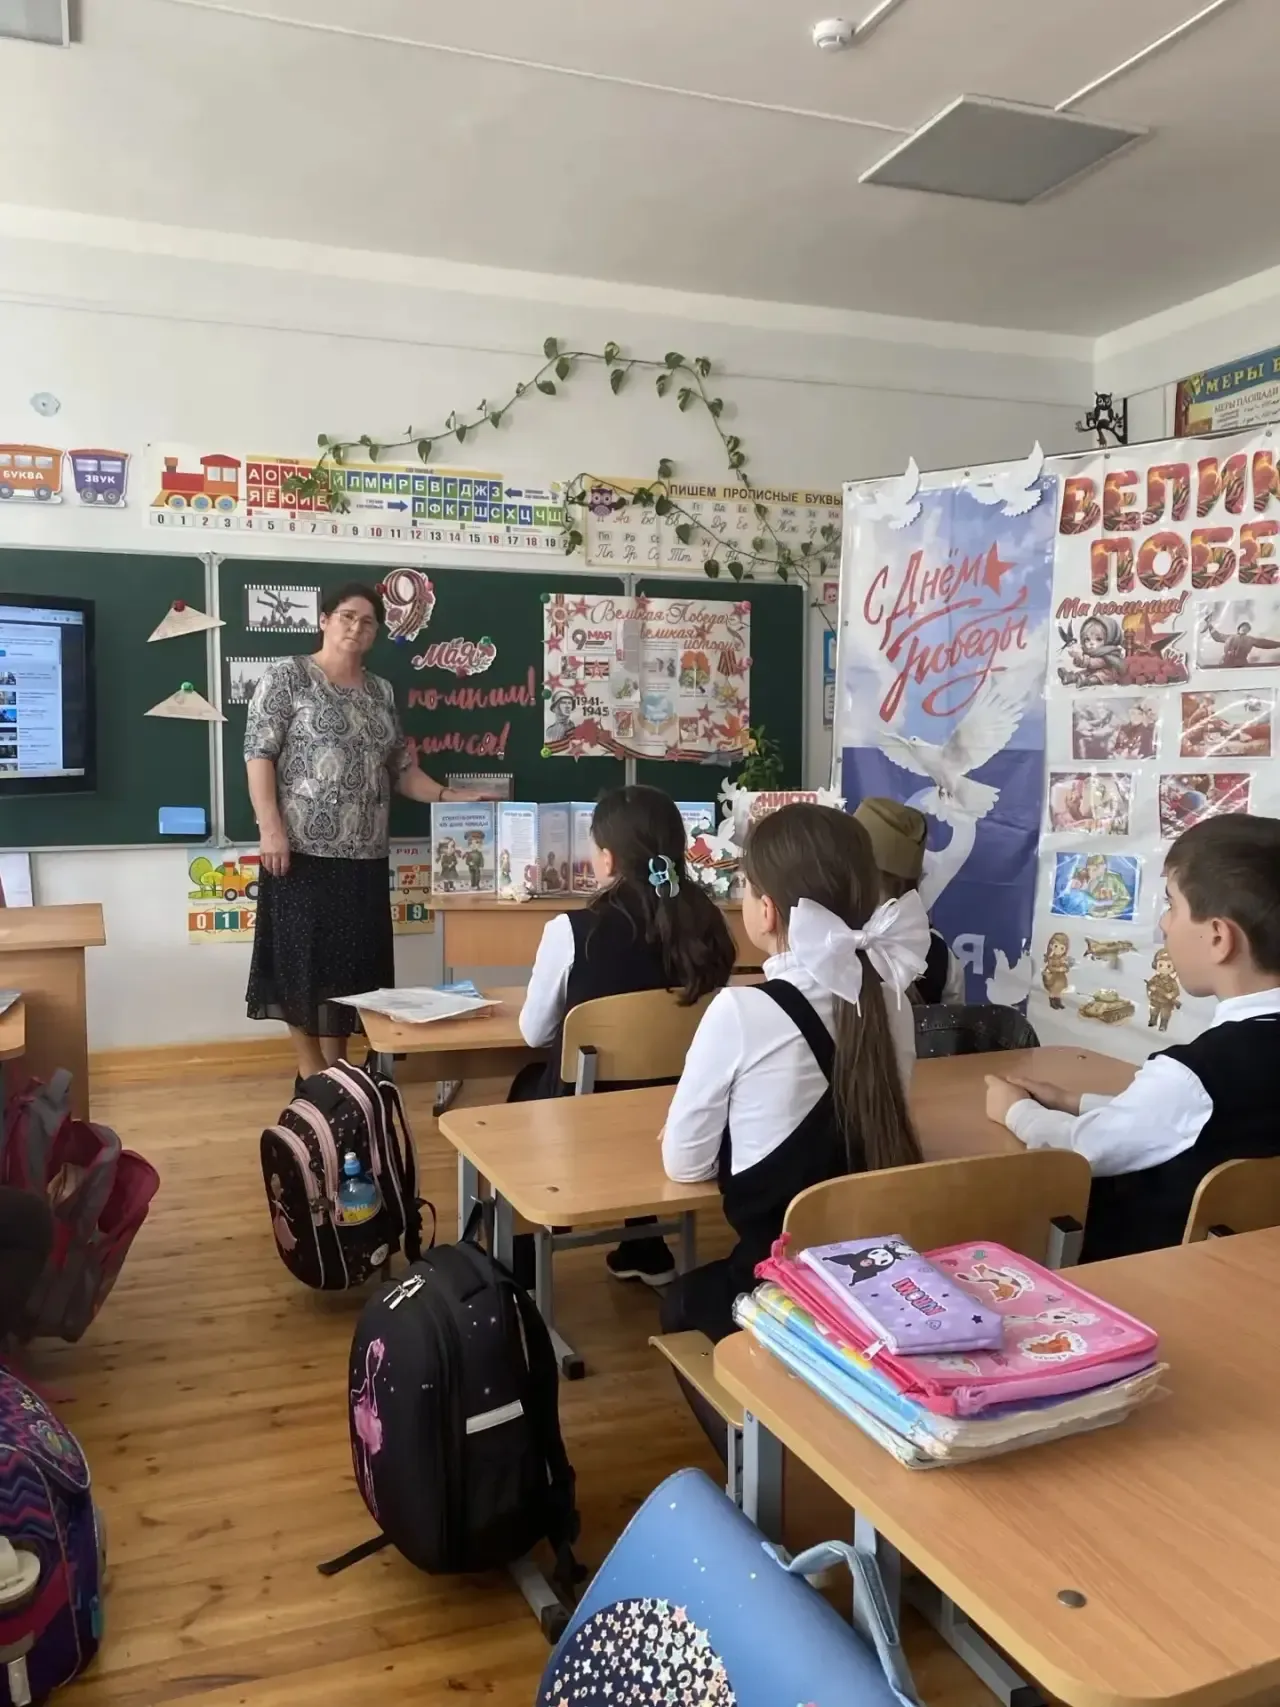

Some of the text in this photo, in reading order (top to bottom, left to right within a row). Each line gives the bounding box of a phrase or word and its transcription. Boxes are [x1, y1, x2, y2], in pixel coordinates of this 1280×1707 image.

[1206, 362, 1264, 395] МЕРЫ
[3, 470, 44, 480] БУКВА
[84, 474, 116, 484] ЗВУК
[249, 468, 260, 480] А
[265, 470, 278, 481] О
[349, 475, 360, 486] Л
[365, 476, 377, 488] М
[382, 478, 393, 489] Н
[399, 479, 409, 490] Р
[415, 480, 425, 491] Б
[430, 481, 441, 492] В
[447, 483, 455, 493] Г
[461, 484, 472, 496] Д
[474, 485, 488, 496] Ж
[491, 487, 500, 497] З
[249, 490, 260, 502] Я
[267, 488, 277, 503] Ё
[281, 492, 296, 504] Ю
[415, 502, 424, 513] П
[429, 503, 441, 514] Ф
[446, 504, 455, 515] К
[461, 506, 472, 516] Т
[491, 508, 501, 518] С
[505, 508, 516, 519] Х
[520, 510, 531, 522] Ц
[536, 510, 545, 521] Ч
[670, 484, 843, 505] ПИШЕМ ПРОПИСНЫЕ БУКВЫ
[157, 513, 165, 525] 0
[180, 515, 186, 525] 1
[202, 516, 209, 526] 2
[224, 518, 231, 528] 3
[246, 519, 253, 529] 4
[268, 520, 275, 531] 5
[289, 522, 296, 532] 6
[310, 523, 317, 533] 7
[332, 524, 338, 534] 8
[352, 526, 359, 536] 9
[370, 527, 382, 537] 10
[390, 528, 401, 538] 11
[411, 530, 422, 540] 12
[430, 531, 442, 541] 13
[450, 532, 461, 542] 14
[469, 533, 481, 543] 15
[489, 535, 500, 544] 16
[508, 536, 519, 545] 17
[526, 537, 537, 546] 18
[545, 538, 556, 547] 19
[590, 599, 728, 626] Великая Победа
[863, 548, 983, 650] С Днём
[1092, 589, 1188, 617] помним!
[572, 628, 613, 650] 9 МАЯ
[683, 637, 741, 652] история
[411, 639, 477, 668] Мая
[879, 585, 1029, 723] Победы
[576, 696, 604, 706] 1941-
[582, 706, 610, 717] 1945
[196, 912, 208, 929] 0
[222, 912, 230, 928] 1
[246, 911, 257, 928] 2
[412, 904, 422, 920] 9
